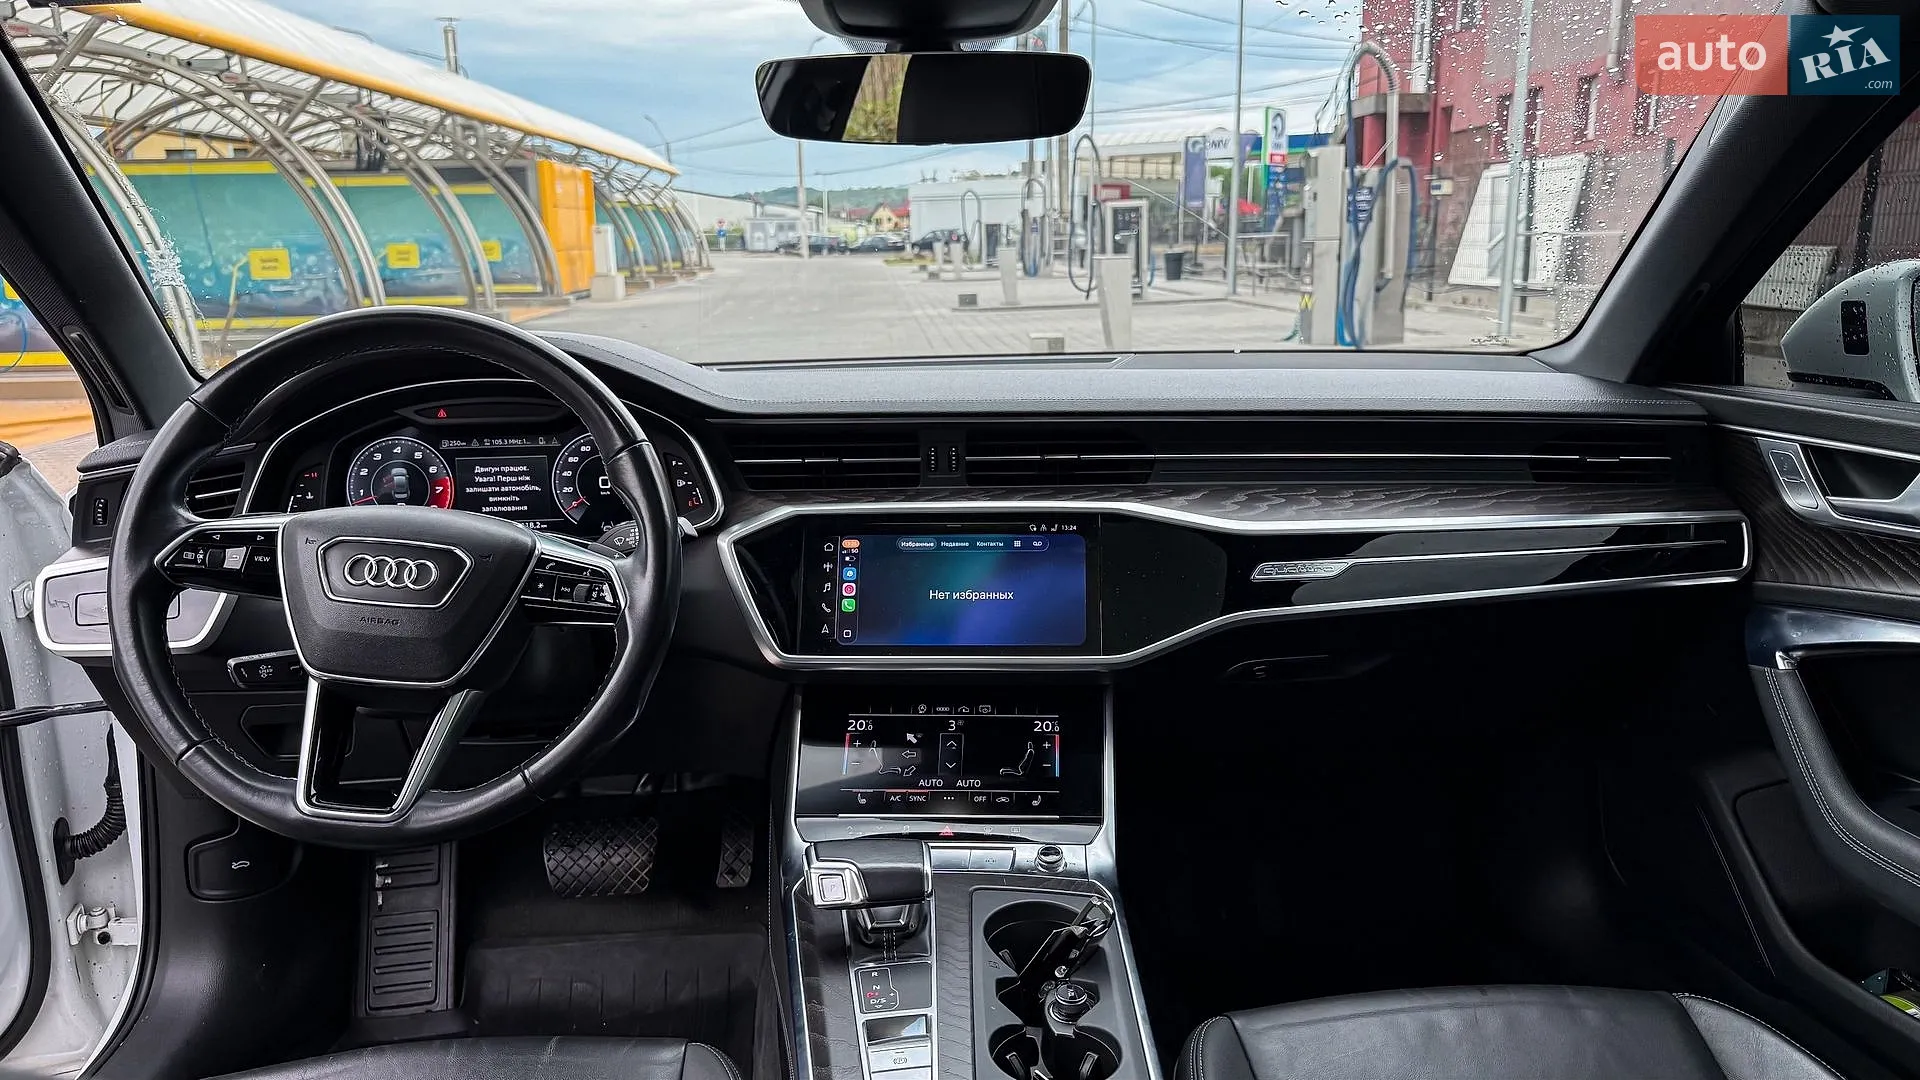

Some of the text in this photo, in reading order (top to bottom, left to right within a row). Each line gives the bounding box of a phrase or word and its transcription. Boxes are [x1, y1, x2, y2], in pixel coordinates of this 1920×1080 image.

[360, 468, 369, 476] 2
[429, 466, 437, 474] 6
[474, 465, 529, 474] Двигун працює.
[435, 486, 443, 494] 7
[500, 484, 541, 492] автомобіль,
[929, 589, 1014, 602] Нет избранных
[360, 616, 400, 625] AIRBAG
[948, 720, 956, 731] 3
[918, 779, 944, 787] AUTO
[956, 779, 981, 788] AUTO
